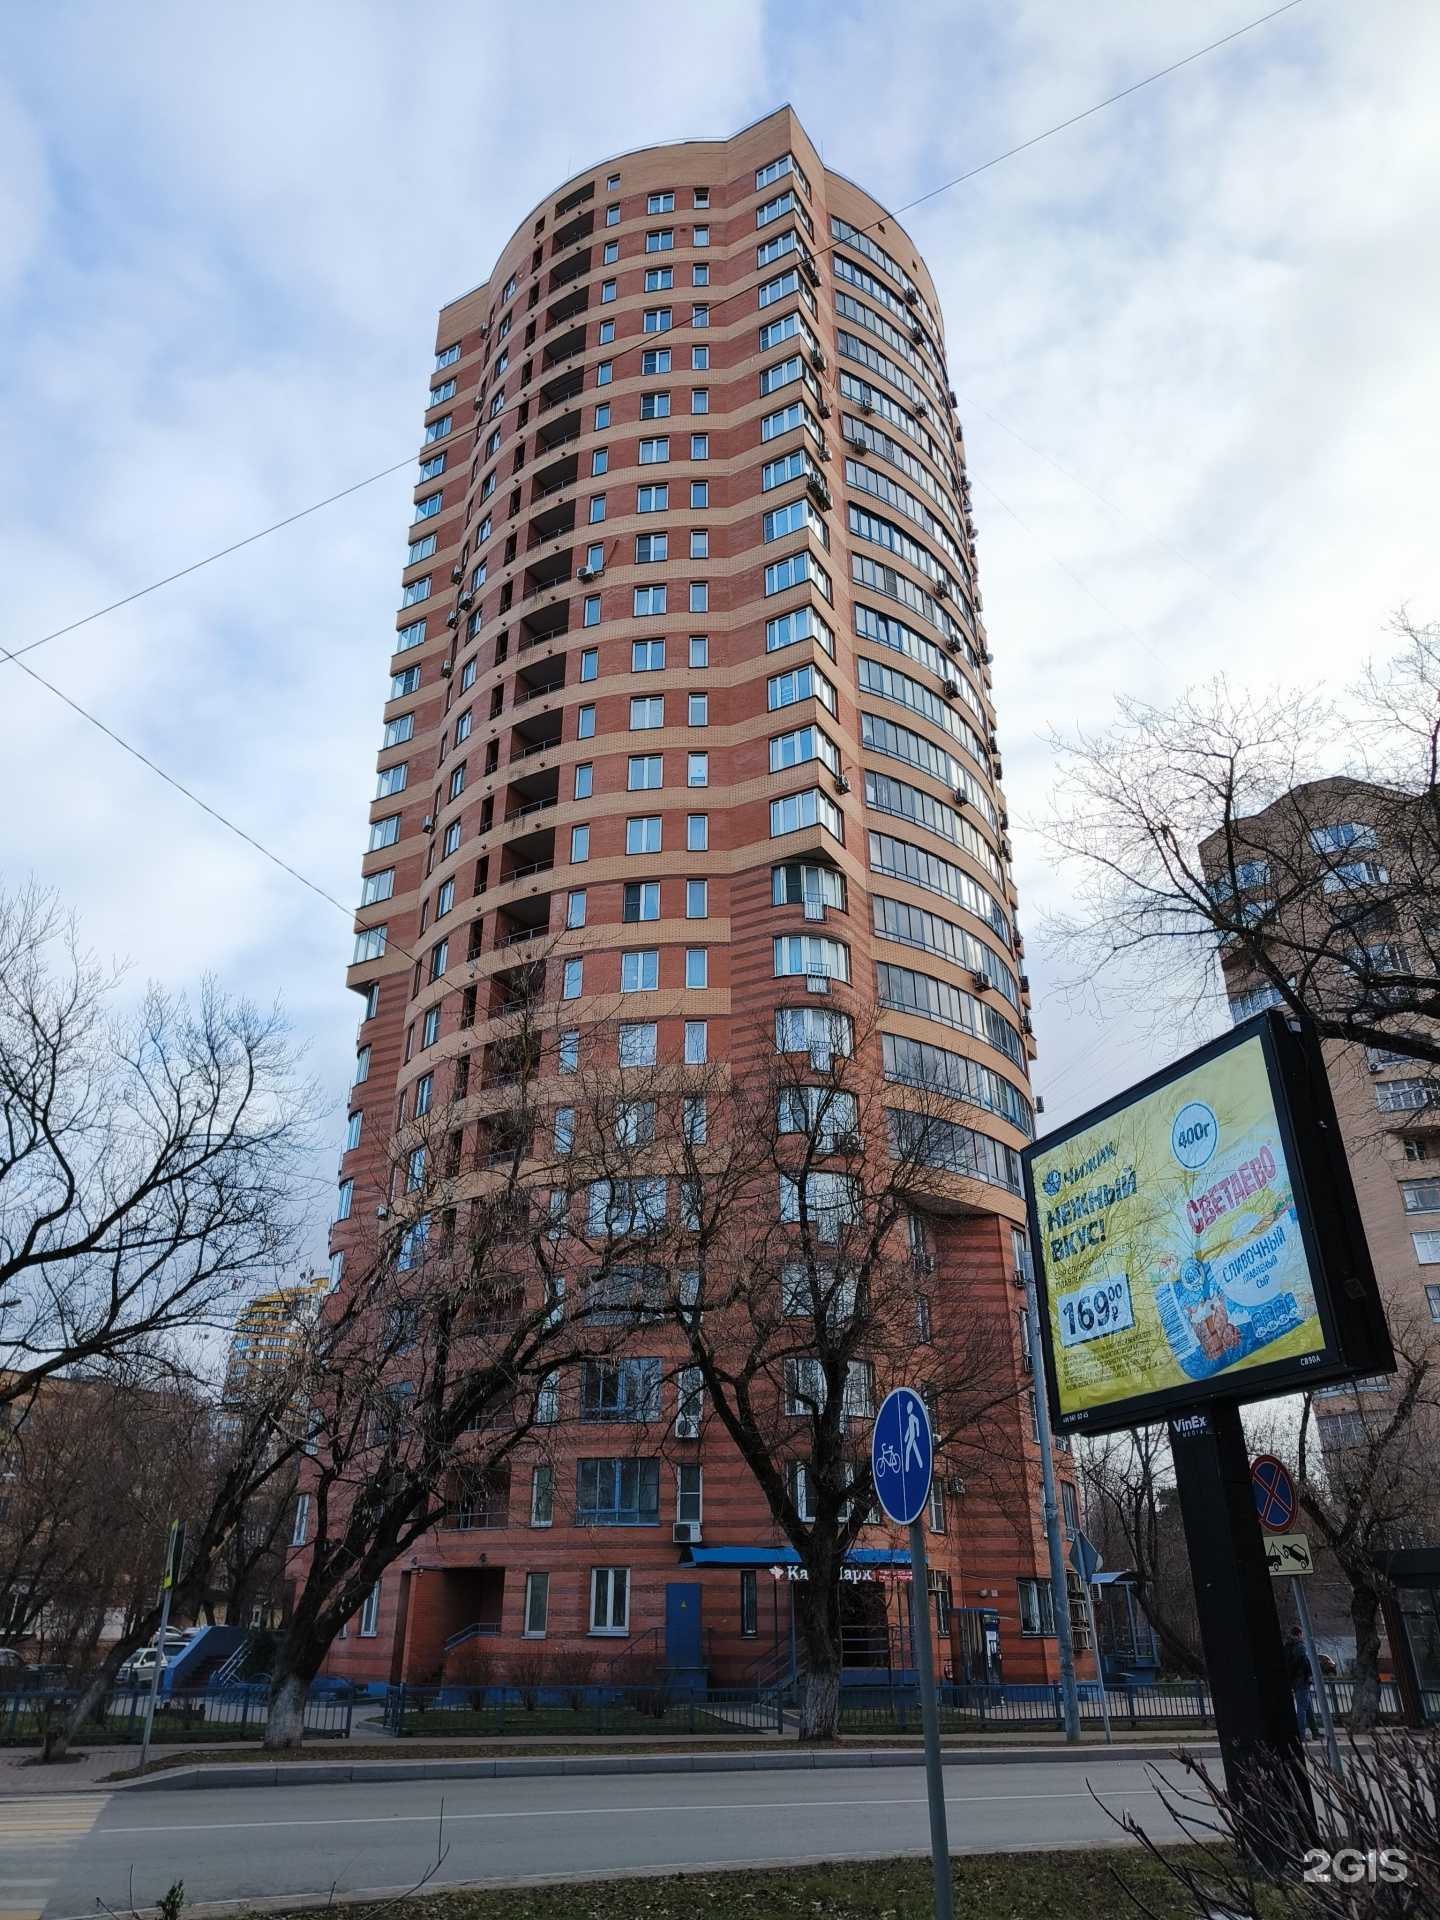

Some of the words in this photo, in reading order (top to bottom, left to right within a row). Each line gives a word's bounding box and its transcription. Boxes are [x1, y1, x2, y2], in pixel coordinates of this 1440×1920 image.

[1047, 1164, 1137, 1232] НЕЖНЫЙ
[1187, 1145, 1276, 1235] СВЕТАЕВО
[1051, 1219, 1106, 1262] ВКУС!
[1222, 1225, 1287, 1283] СЛИВОЧНЫЙ
[1063, 1290, 1110, 1335] 169
[1172, 1415, 1207, 1433] VinEx
